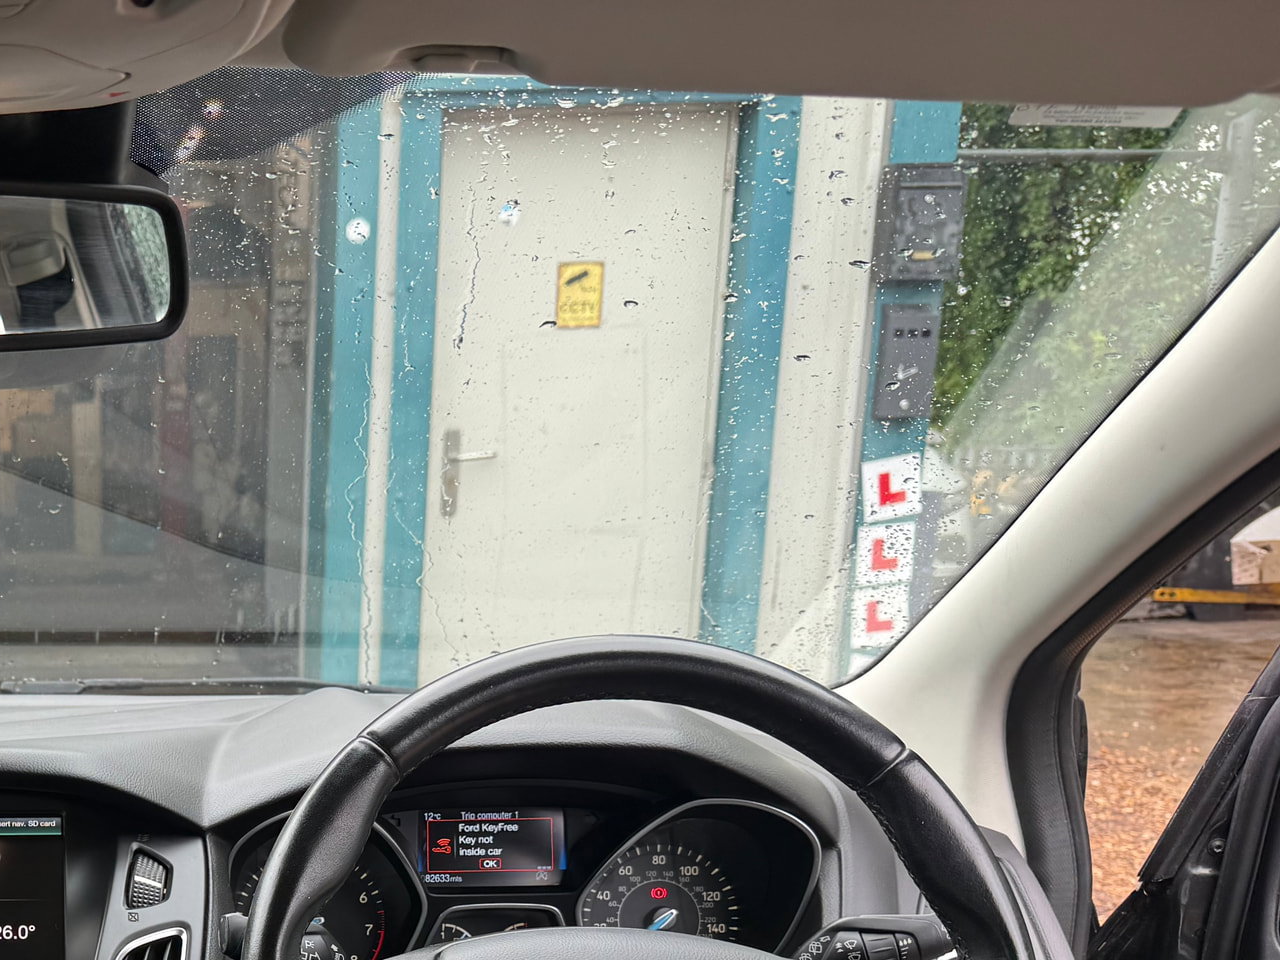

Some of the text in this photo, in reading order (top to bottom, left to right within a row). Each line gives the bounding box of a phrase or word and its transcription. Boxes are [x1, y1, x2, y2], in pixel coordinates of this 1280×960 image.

[878, 473, 907, 506] L
[871, 538, 899, 572] L
[866, 601, 895, 633] L
[461, 811, 476, 820] Trip
[477, 812, 513, 820] computer
[458, 822, 519, 833] Ford KeyFree
[458, 835, 494, 846] Key not
[459, 847, 503, 856] inside car
[483, 859, 498, 868] OK
[652, 855, 666, 865] 80
[618, 865, 633, 876] 60
[679, 866, 699, 876] 100
[359, 891, 368, 904] 6
[596, 890, 611, 900] 40
[701, 891, 721, 901] 120
[365, 924, 373, 936] 7
[707, 923, 726, 933] 140
